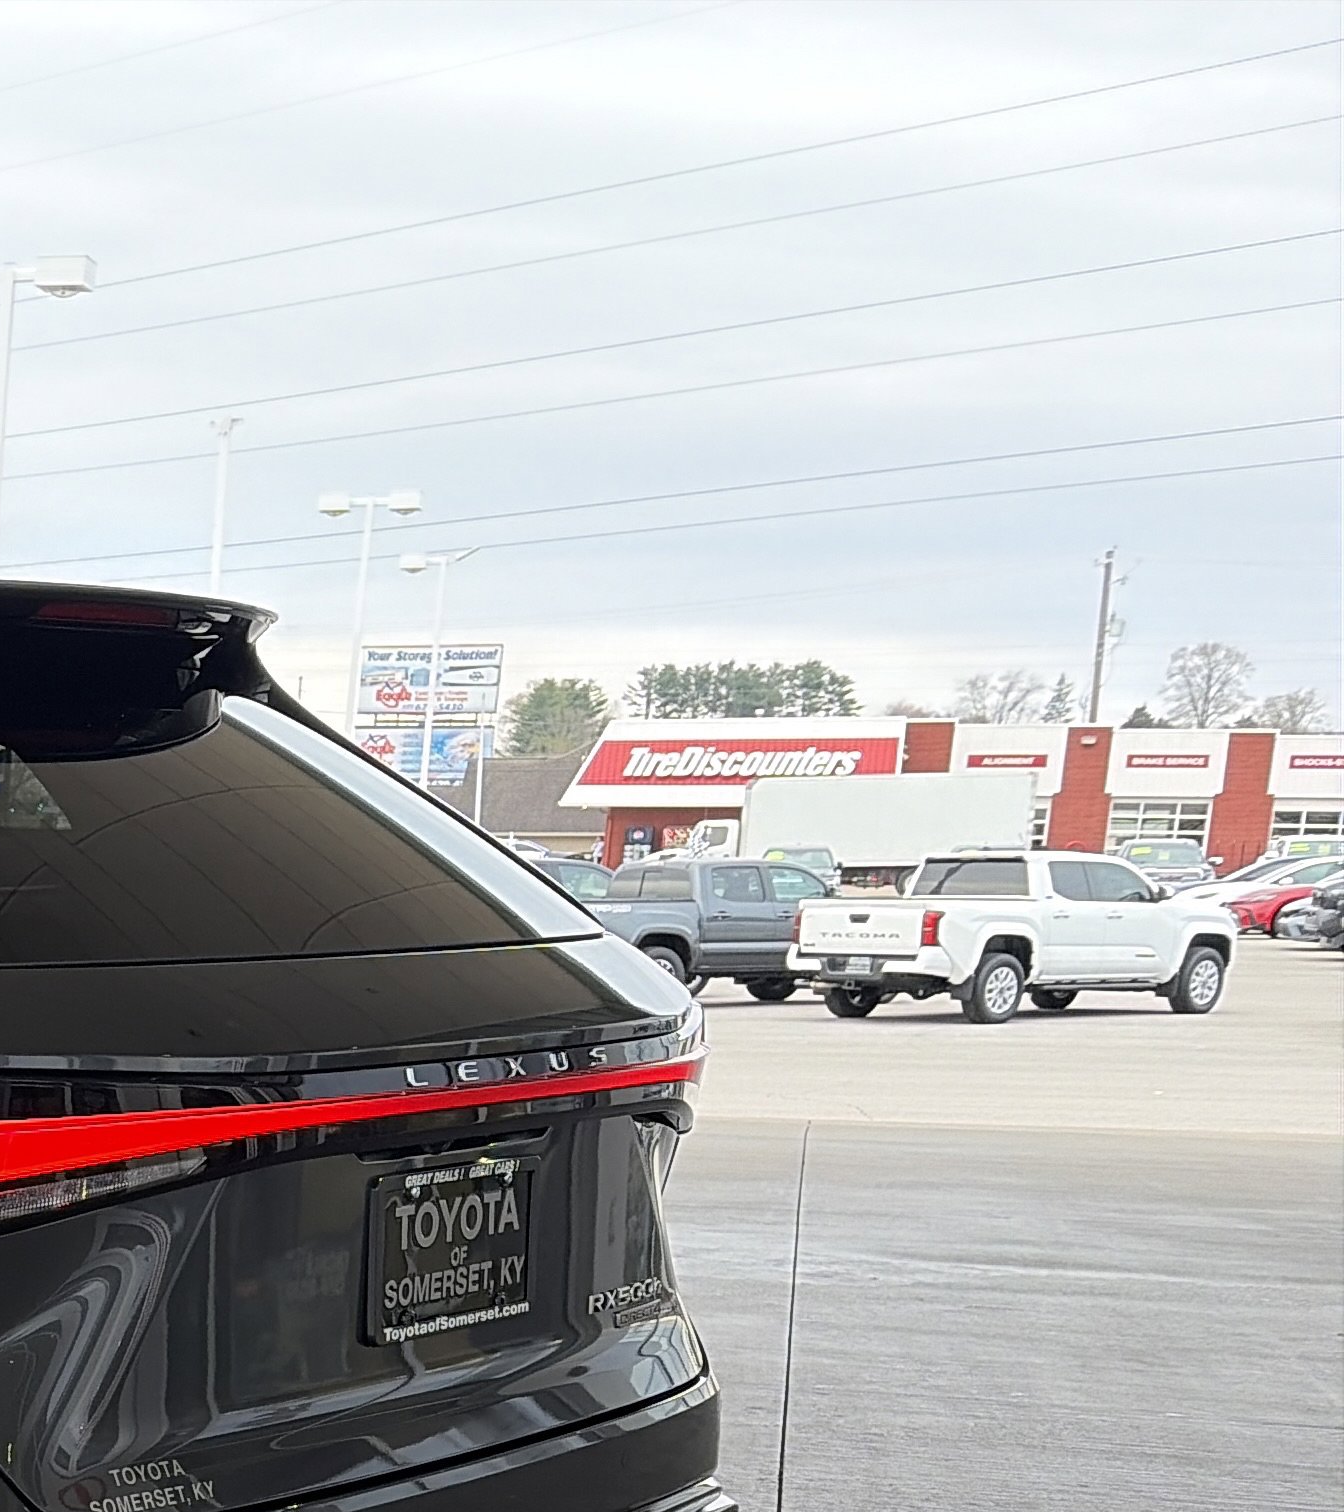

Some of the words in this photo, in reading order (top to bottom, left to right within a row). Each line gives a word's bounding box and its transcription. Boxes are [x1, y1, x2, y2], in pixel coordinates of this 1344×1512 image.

[367, 650, 393, 662] Your
[395, 650, 441, 663] Storag
[443, 648, 498, 660] Solution!
[1132, 757, 1164, 766] BRAKE
[1166, 757, 1205, 766] SERVICE
[819, 931, 901, 939] TACOMA
[405, 1046, 609, 1088] LEXUS
[405, 1172, 431, 1189] GREAT
[469, 1164, 493, 1179] GREAT
[395, 1187, 520, 1250] TOYOTA
[451, 1245, 468, 1267] OF
[384, 1260, 495, 1309] SOMERSET,
[500, 1254, 526, 1287] KY
[383, 1301, 530, 1343] ToyotaofSomerset.com
[108, 1459, 186, 1487] TOYOTA
[192, 1480, 214, 1501] KY
